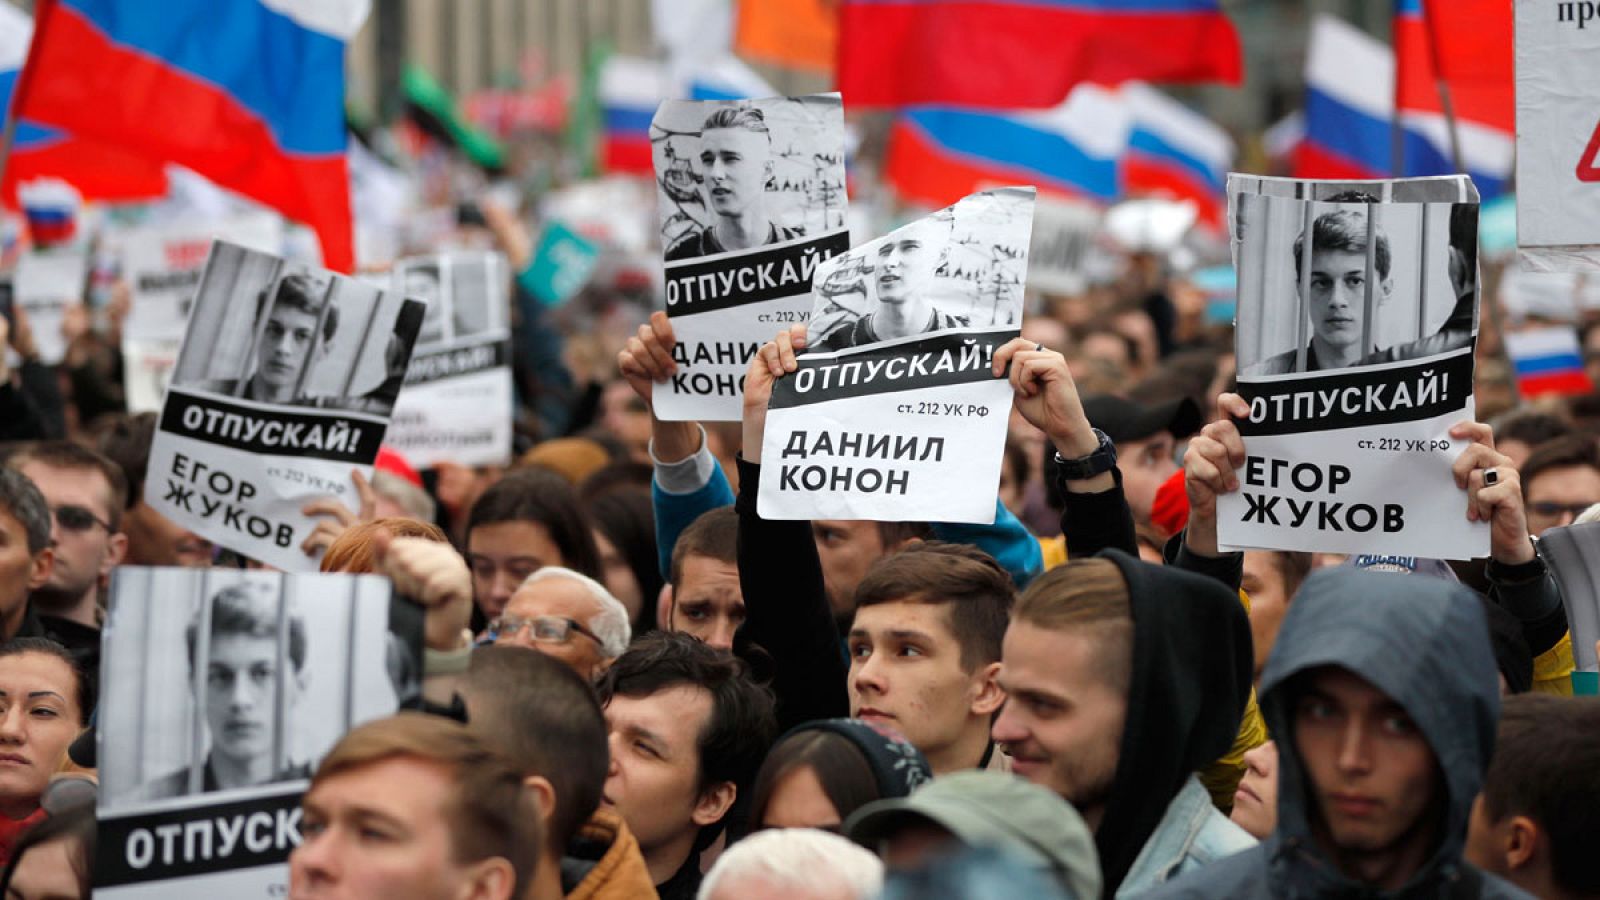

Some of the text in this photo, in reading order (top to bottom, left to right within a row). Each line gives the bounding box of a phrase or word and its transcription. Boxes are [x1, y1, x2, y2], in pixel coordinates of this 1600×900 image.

[1557, 1, 1600, 30] пр
[758, 314, 774, 322] ст.
[775, 311, 795, 322] 212
[671, 341, 768, 367] ДАНИ
[794, 338, 993, 393] ОТПУСКАЙ!
[671, 372, 746, 397] КОН
[1248, 369, 1449, 424] ОТПУСКАЙ!
[897, 402, 989, 417] ст. 212 УК РФ
[182, 404, 363, 453] ОТПУСКАЙ!
[781, 430, 945, 462] ДАНИИЛ
[1358, 437, 1451, 452] ст. 212 УК РФ
[171, 452, 257, 502] ЕГОР
[779, 464, 910, 495] КОНОН
[1246, 455, 1352, 494] ЕГОР
[164, 479, 294, 548] ЖУКОВ
[1241, 492, 1406, 533] ЖУКОВ
[125, 807, 305, 869] ОТПУСК
